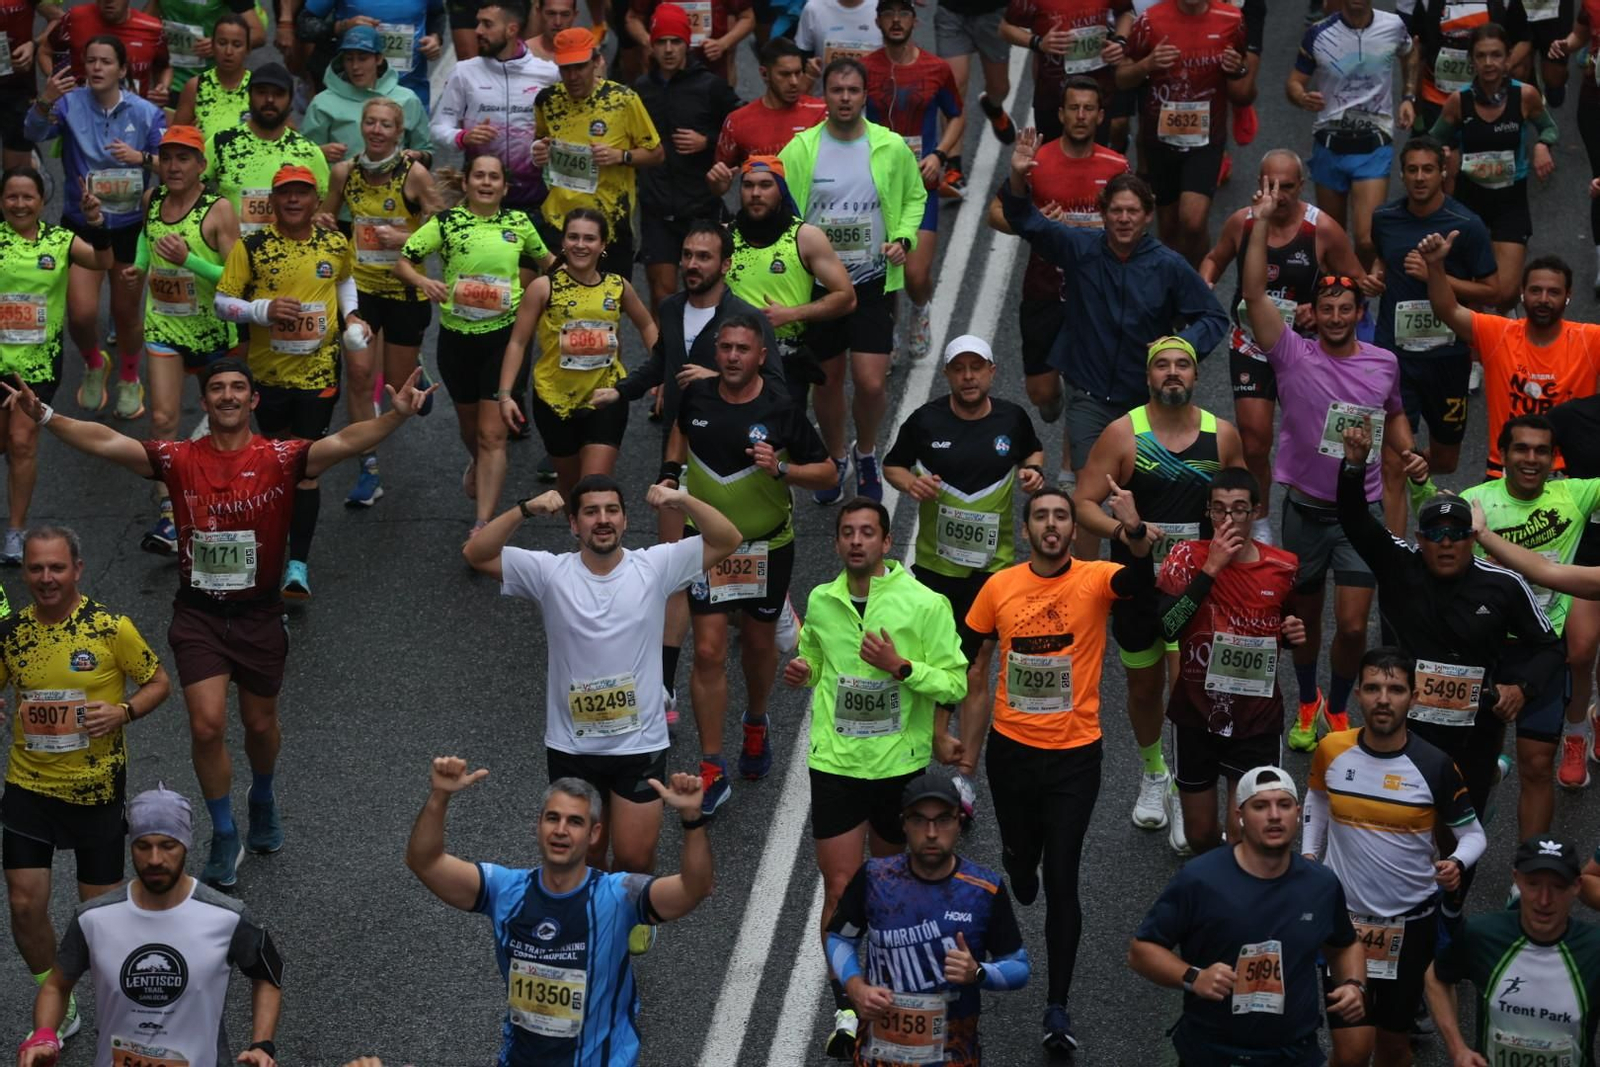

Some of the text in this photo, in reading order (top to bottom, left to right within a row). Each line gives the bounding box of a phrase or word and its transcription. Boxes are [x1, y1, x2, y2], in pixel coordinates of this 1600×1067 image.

[1166, 114, 1198, 127] 5632
[555, 151, 587, 171] 7746
[825, 227, 860, 243] 6956
[462, 284, 499, 303] 5604
[278, 317, 315, 333] 5876
[944, 521, 984, 543] 6596
[716, 559, 752, 576] 5032
[1220, 648, 1264, 671] 8506
[1014, 668, 1056, 688] 7292
[1423, 677, 1468, 701] 5496
[574, 690, 628, 714] 13249
[844, 690, 887, 712] 8964
[28, 705, 70, 725] 5907
[883, 918, 942, 948] MARATÓN
[943, 910, 973, 923] HOKA
[125, 974, 183, 989] LENTISCO
[143, 986, 165, 994] TRAIL
[515, 977, 571, 1007] 11350
[1497, 1000, 1573, 1025] Trent Park
[880, 1012, 927, 1036] 5158
